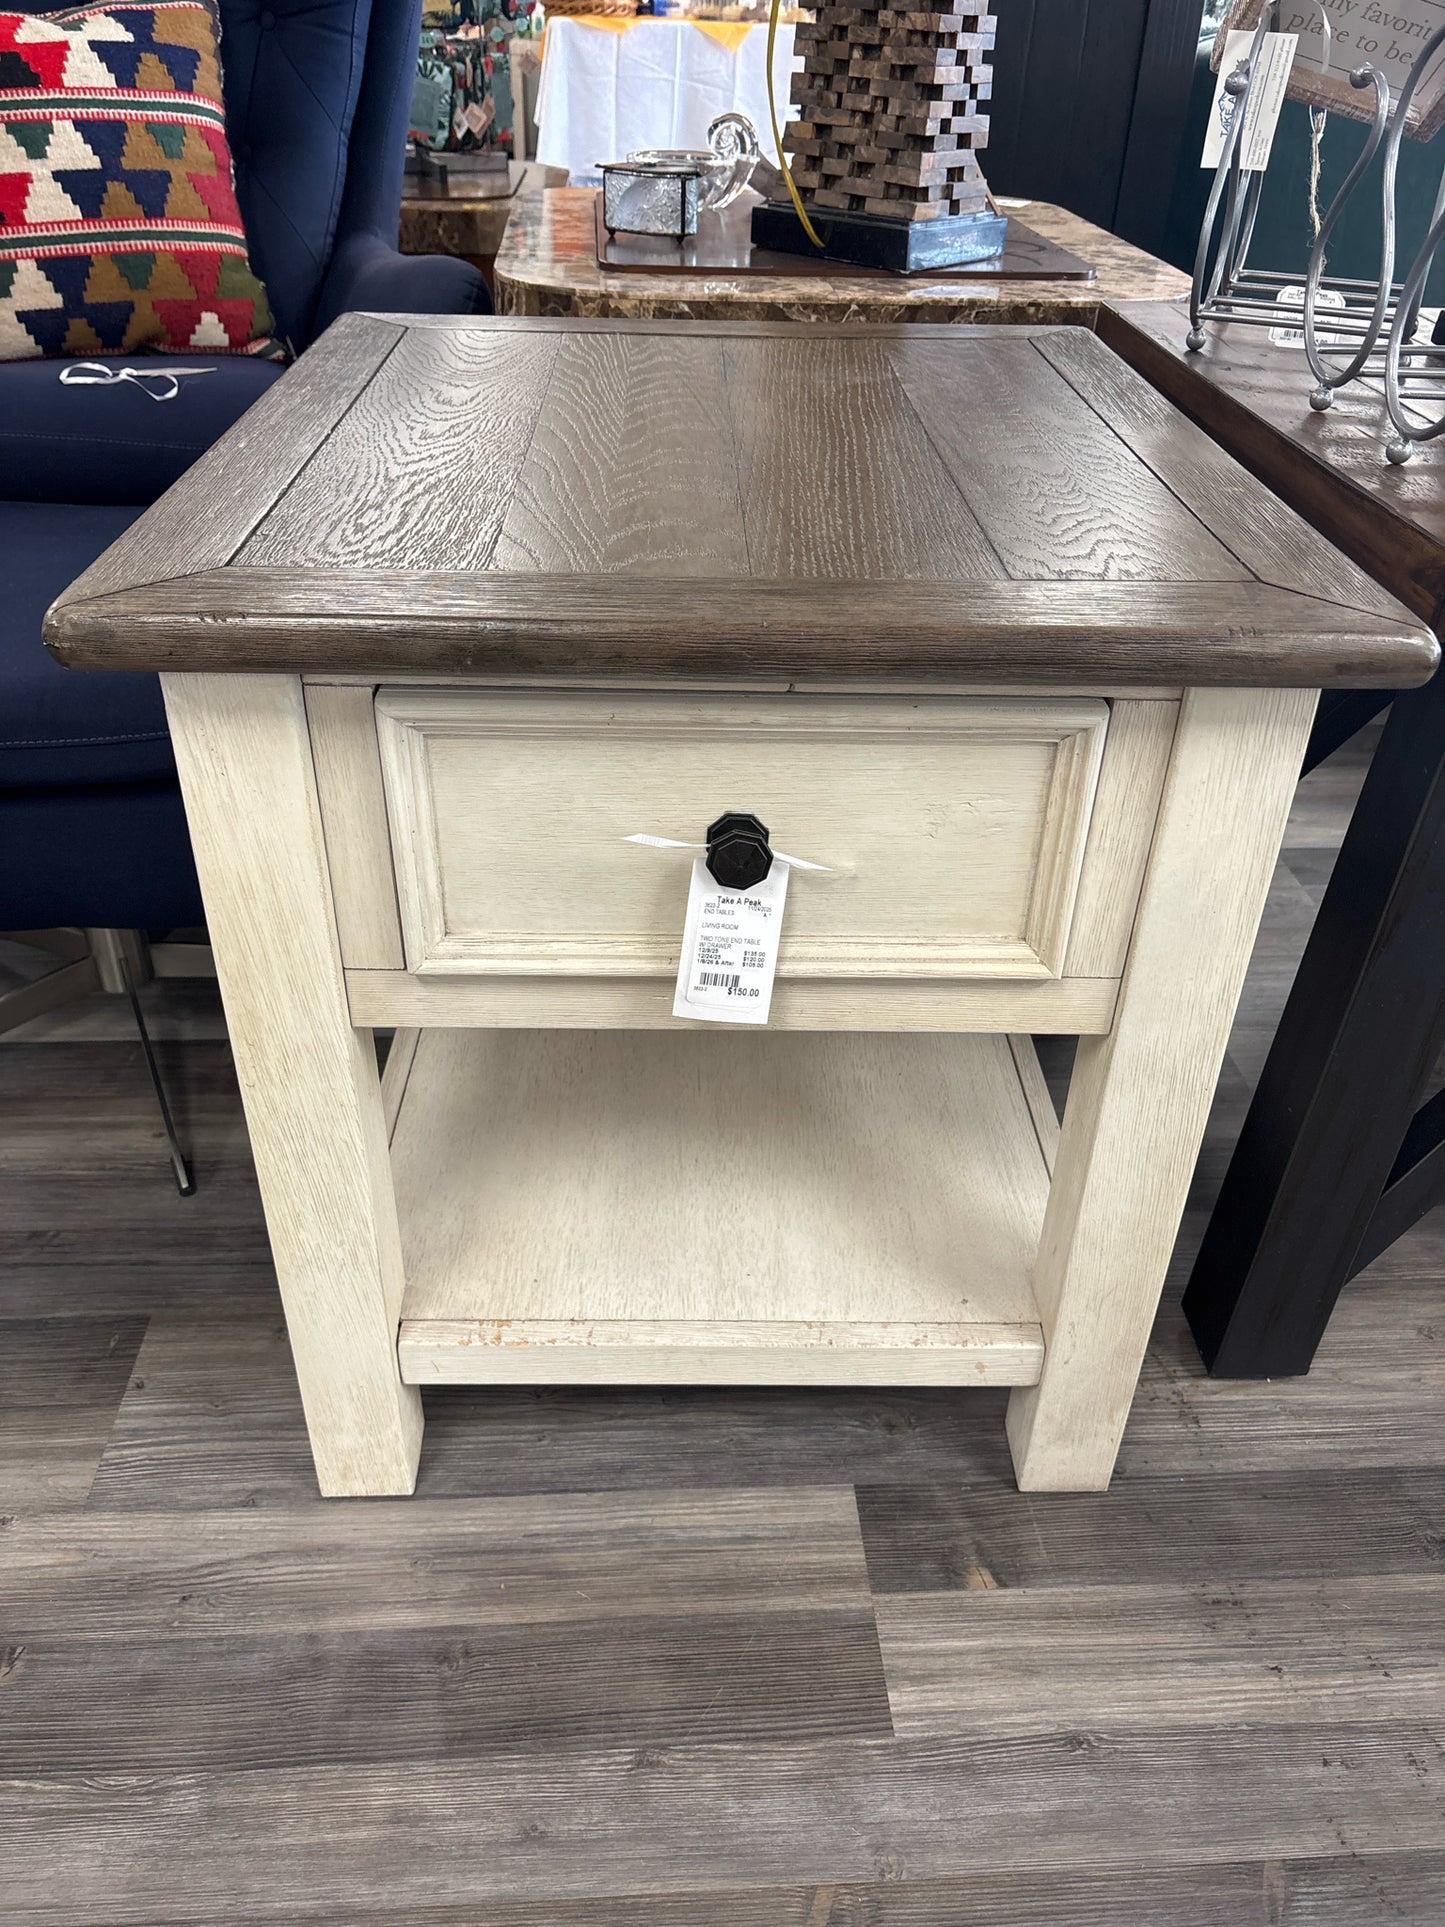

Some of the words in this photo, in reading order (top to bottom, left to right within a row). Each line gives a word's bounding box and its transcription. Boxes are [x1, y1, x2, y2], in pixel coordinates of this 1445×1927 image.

[1321, 0, 1358, 18] my
[1360, 1, 1434, 41] favorit
[1355, 36, 1379, 53] to
[717, 896, 735, 905] Take
[736, 897, 742, 905] A
[744, 898, 762, 906] Peak
[701, 922, 721, 930] LIVING
[744, 938, 761, 946] TABLE
[727, 987, 760, 997] $150.00
